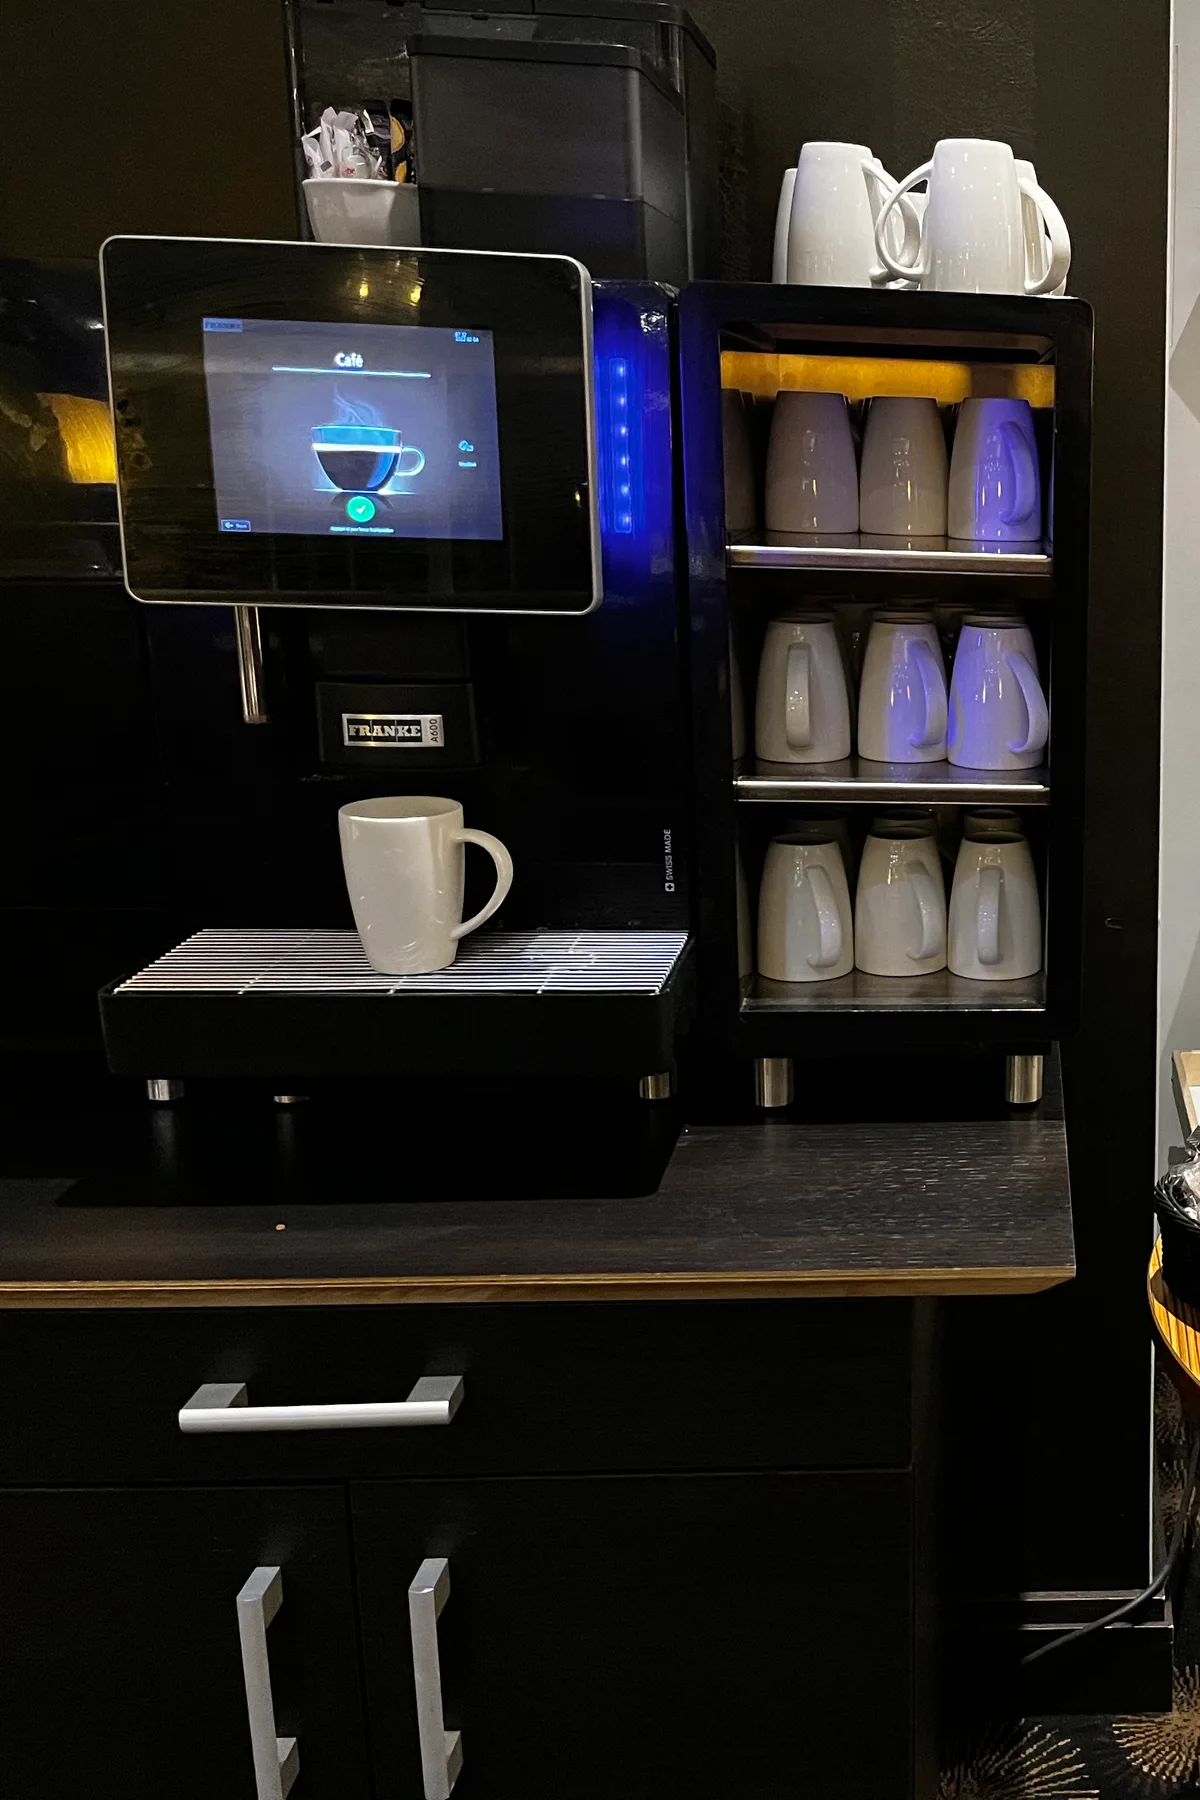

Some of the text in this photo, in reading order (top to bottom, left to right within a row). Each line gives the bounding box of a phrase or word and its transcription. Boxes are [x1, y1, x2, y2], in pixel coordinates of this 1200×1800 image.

[348, 724, 421, 737] FRANKE
[428, 717, 440, 743] A600
[663, 829, 673, 881] SWISS MADE
